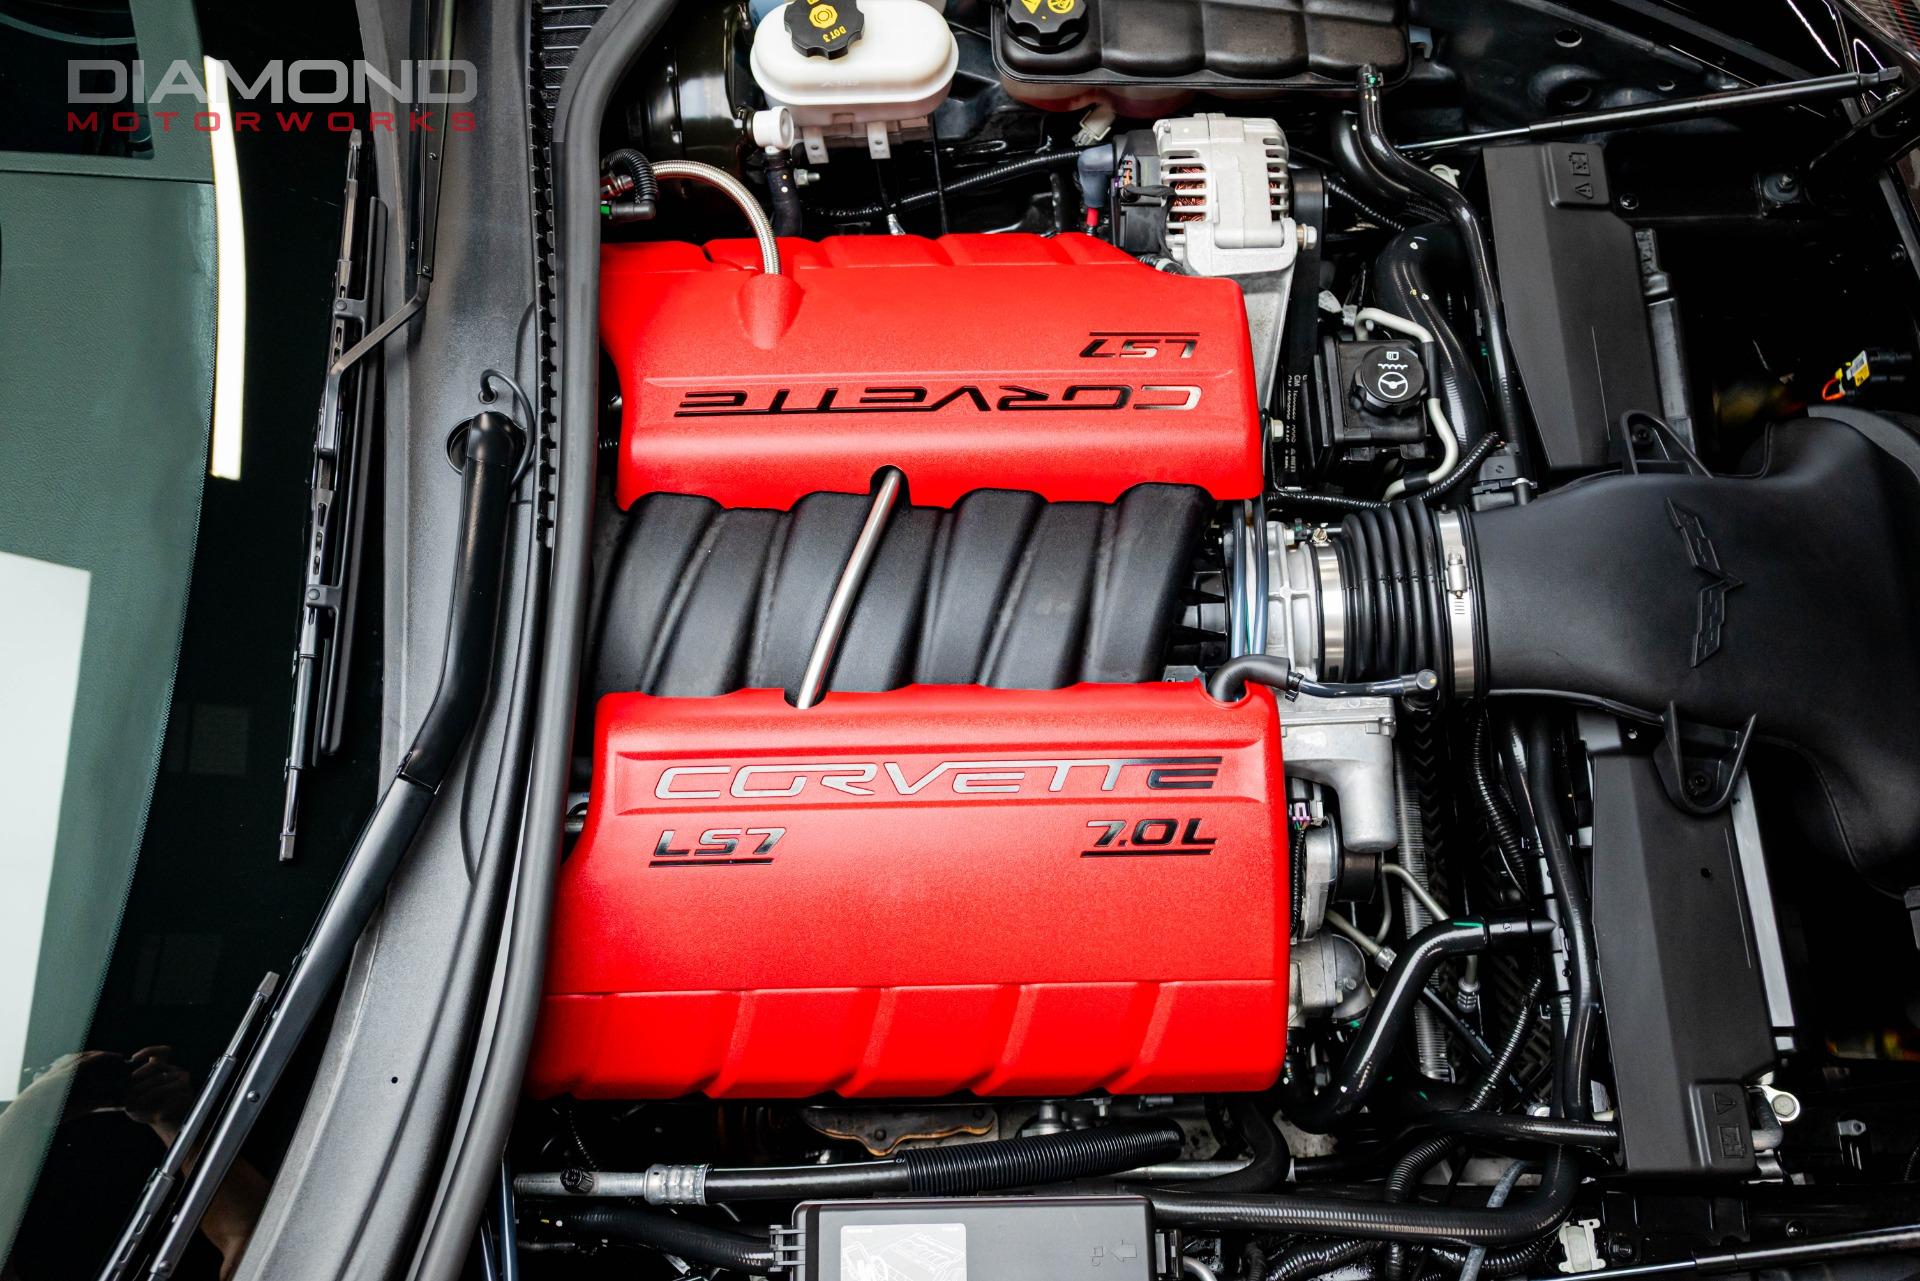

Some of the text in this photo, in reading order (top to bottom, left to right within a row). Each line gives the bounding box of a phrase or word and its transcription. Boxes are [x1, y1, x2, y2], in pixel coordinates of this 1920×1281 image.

[822, 25, 847, 43] DOT 3
[1079, 337, 1199, 360] LS7
[674, 384, 1202, 418] CORVETTE
[654, 755, 1223, 799] CORVETTE
[653, 826, 788, 857] LS7
[1086, 817, 1218, 848] 7.0L
